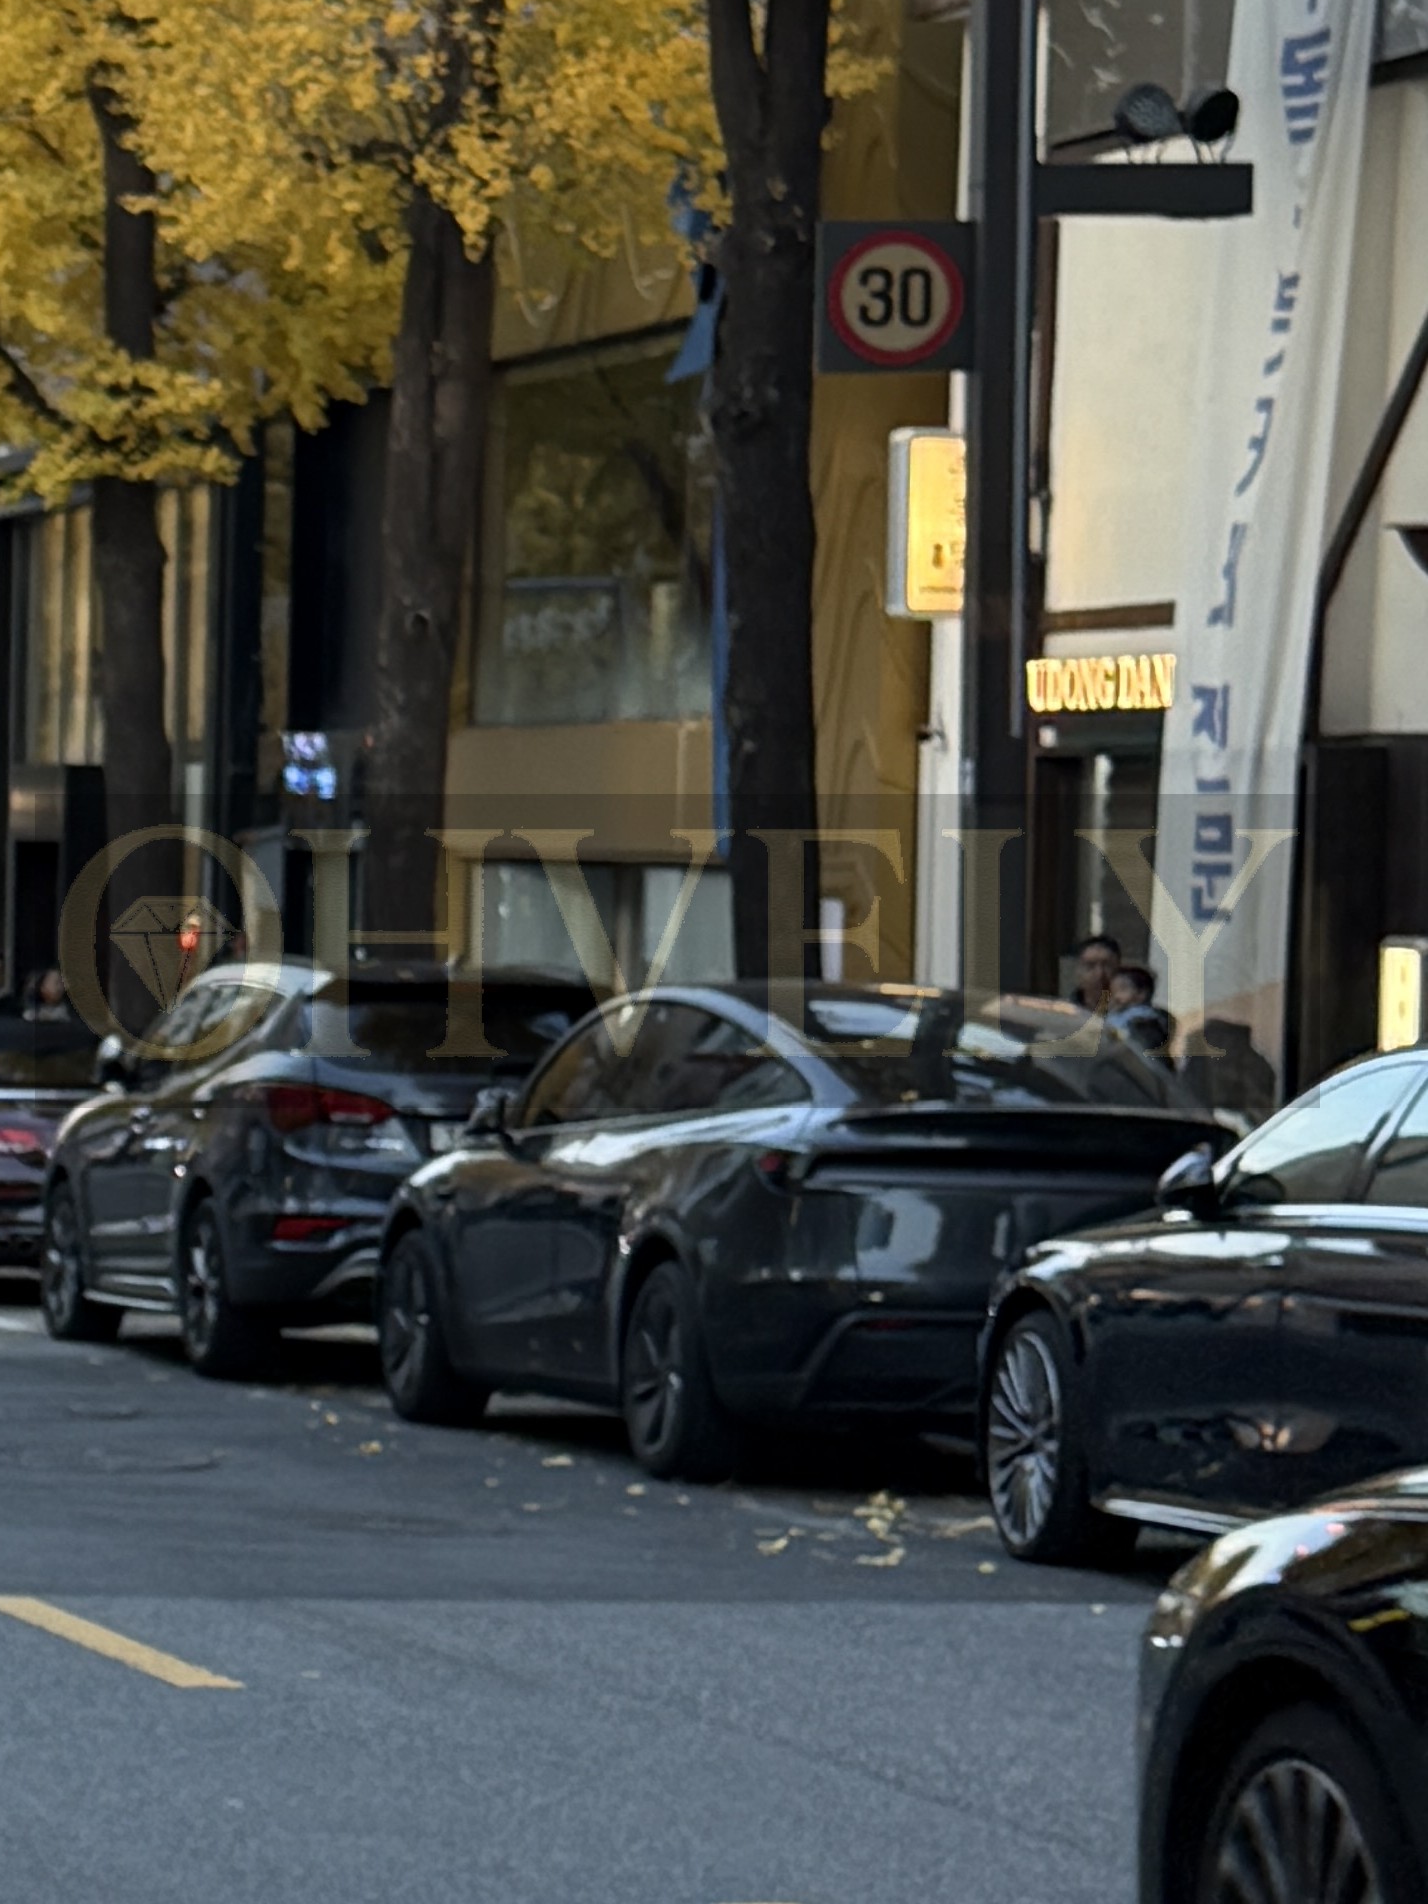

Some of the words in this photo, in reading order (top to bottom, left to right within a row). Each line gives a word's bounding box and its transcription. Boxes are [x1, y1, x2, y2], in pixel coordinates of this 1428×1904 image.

[858, 266, 932, 327] 30
[1026, 656, 1116, 712] UDONG
[1117, 654, 1177, 710] DAN
